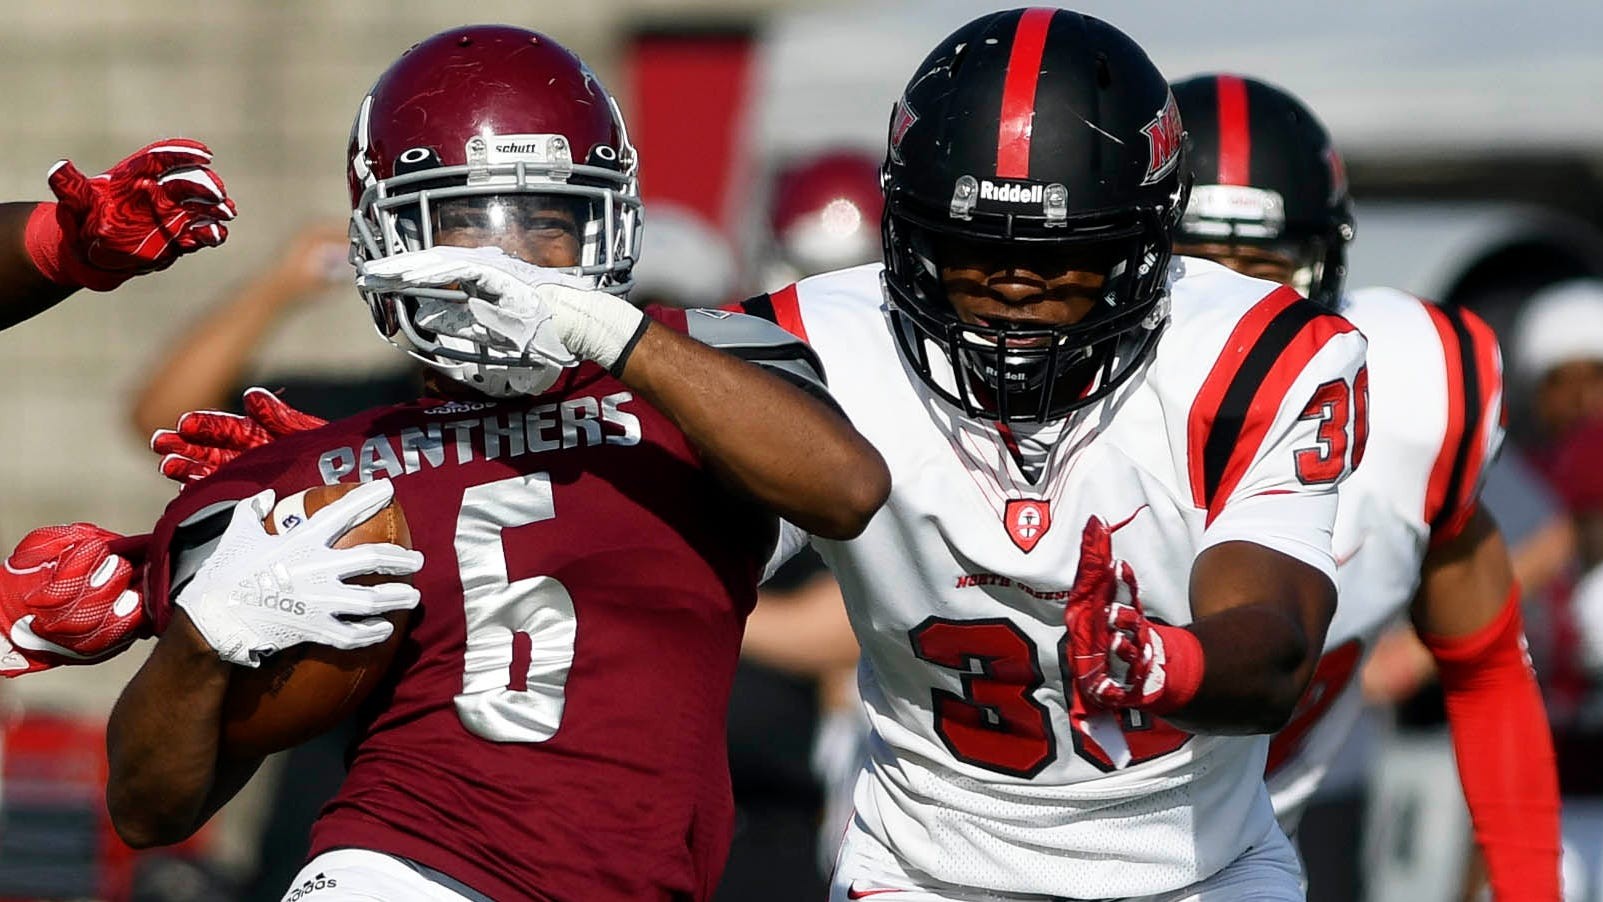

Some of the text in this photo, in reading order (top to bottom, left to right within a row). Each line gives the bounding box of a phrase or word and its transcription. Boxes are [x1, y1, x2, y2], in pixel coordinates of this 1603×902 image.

[495, 143, 536, 154] schutt
[980, 180, 1043, 204] Riddell
[318, 391, 642, 486] PANTHERS
[955, 573, 1012, 589] NORTH
[453, 471, 577, 743] 6
